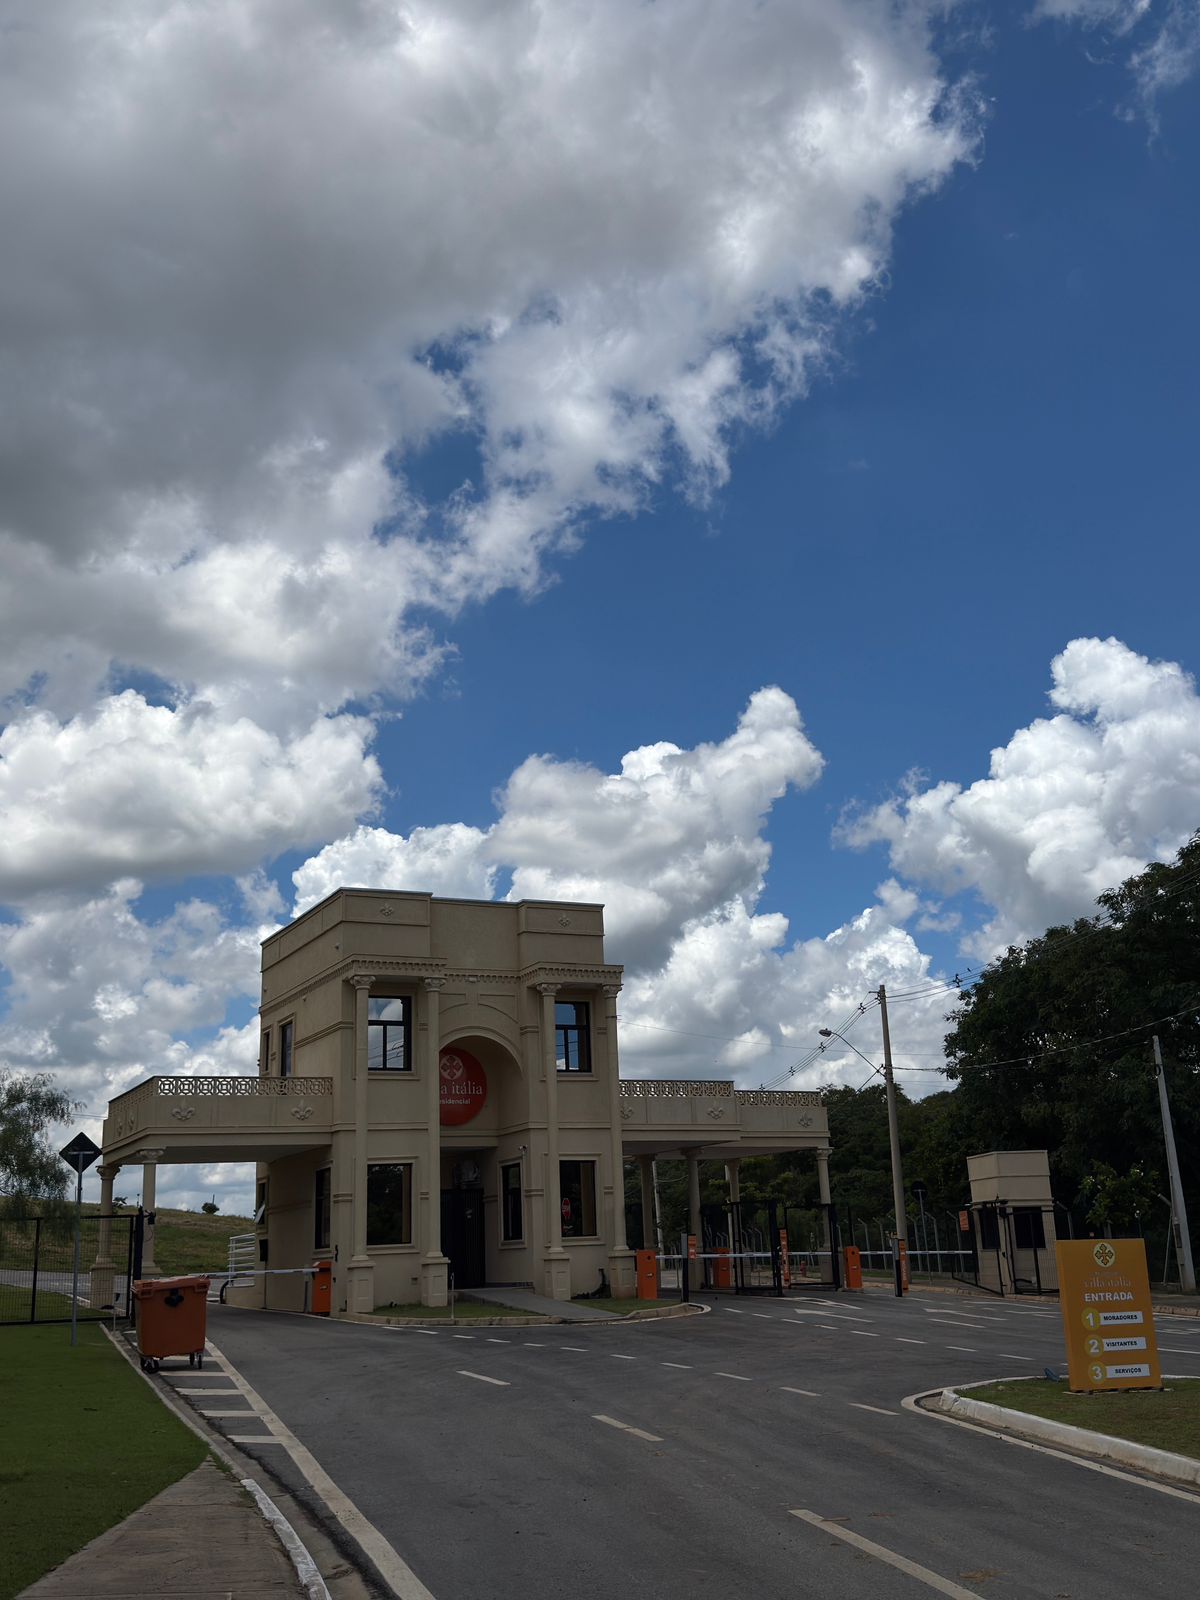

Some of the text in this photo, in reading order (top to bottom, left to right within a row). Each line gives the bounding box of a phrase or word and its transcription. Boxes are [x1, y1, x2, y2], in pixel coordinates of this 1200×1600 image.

[452, 1081, 483, 1095] itália
[1084, 1291, 1134, 1302] ENTRADA
[1086, 1312, 1095, 1328] 1
[1088, 1339, 1100, 1353] 2
[1091, 1365, 1142, 1380] 3 SERVIÇOS
